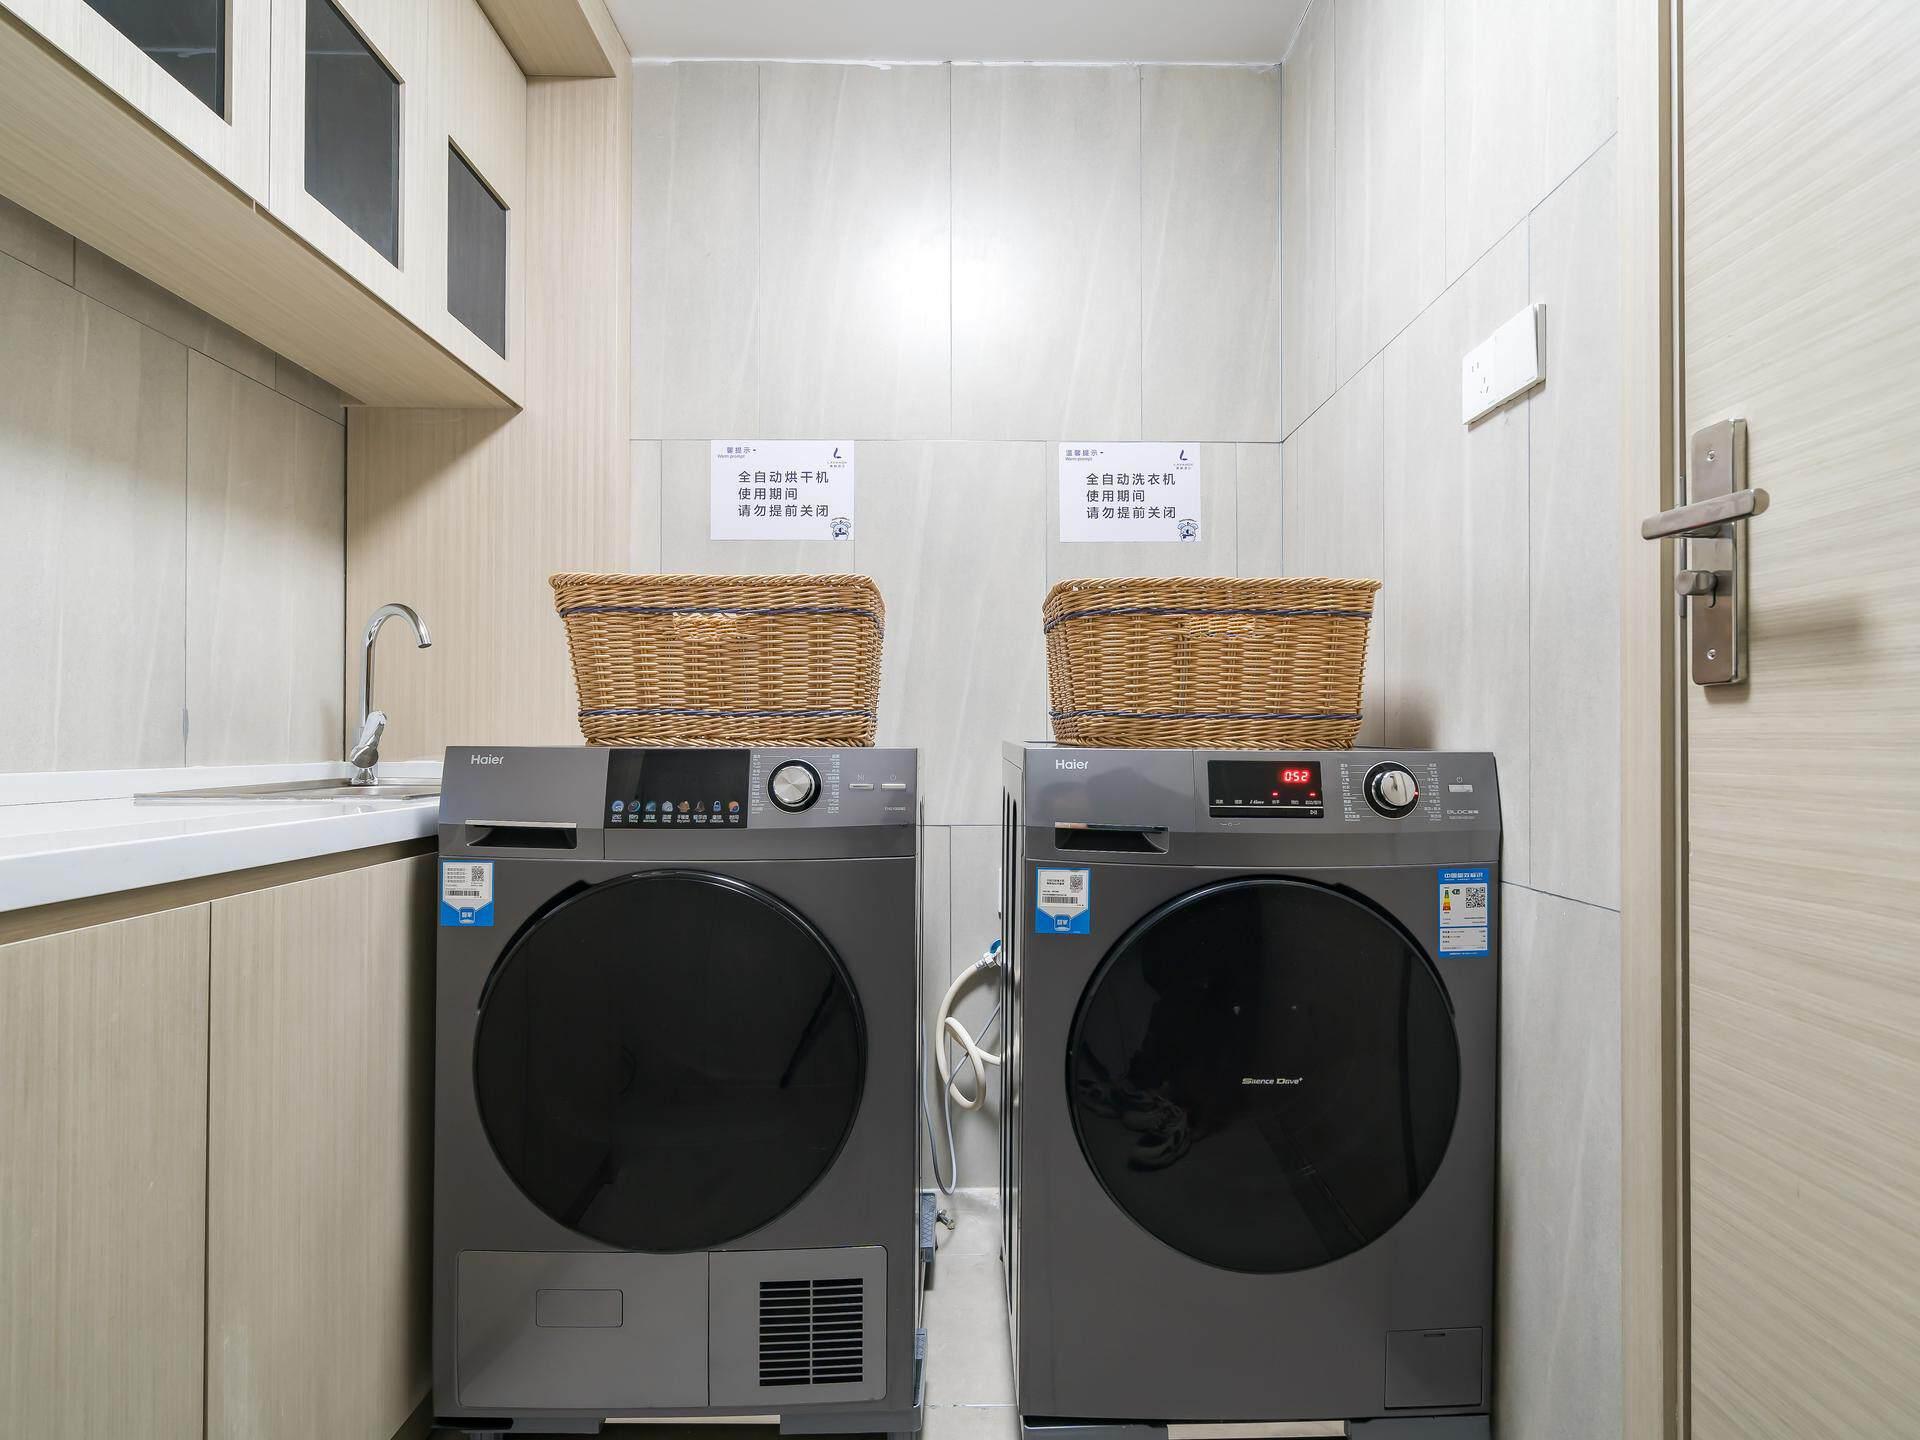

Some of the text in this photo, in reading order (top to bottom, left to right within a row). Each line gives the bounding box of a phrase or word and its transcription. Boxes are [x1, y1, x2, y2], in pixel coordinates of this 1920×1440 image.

[738, 470, 829, 484] 全自动烘干机
[1086, 473, 1176, 486] 全自动洗衣机
[738, 487, 798, 500] 使用期间
[1086, 490, 1145, 502] 使用期间
[738, 504, 829, 517] 请勿提前关闭
[1086, 506, 1176, 519] 请勿提前关闭
[471, 754, 504, 765] Haier
[1055, 759, 1089, 770] Haier
